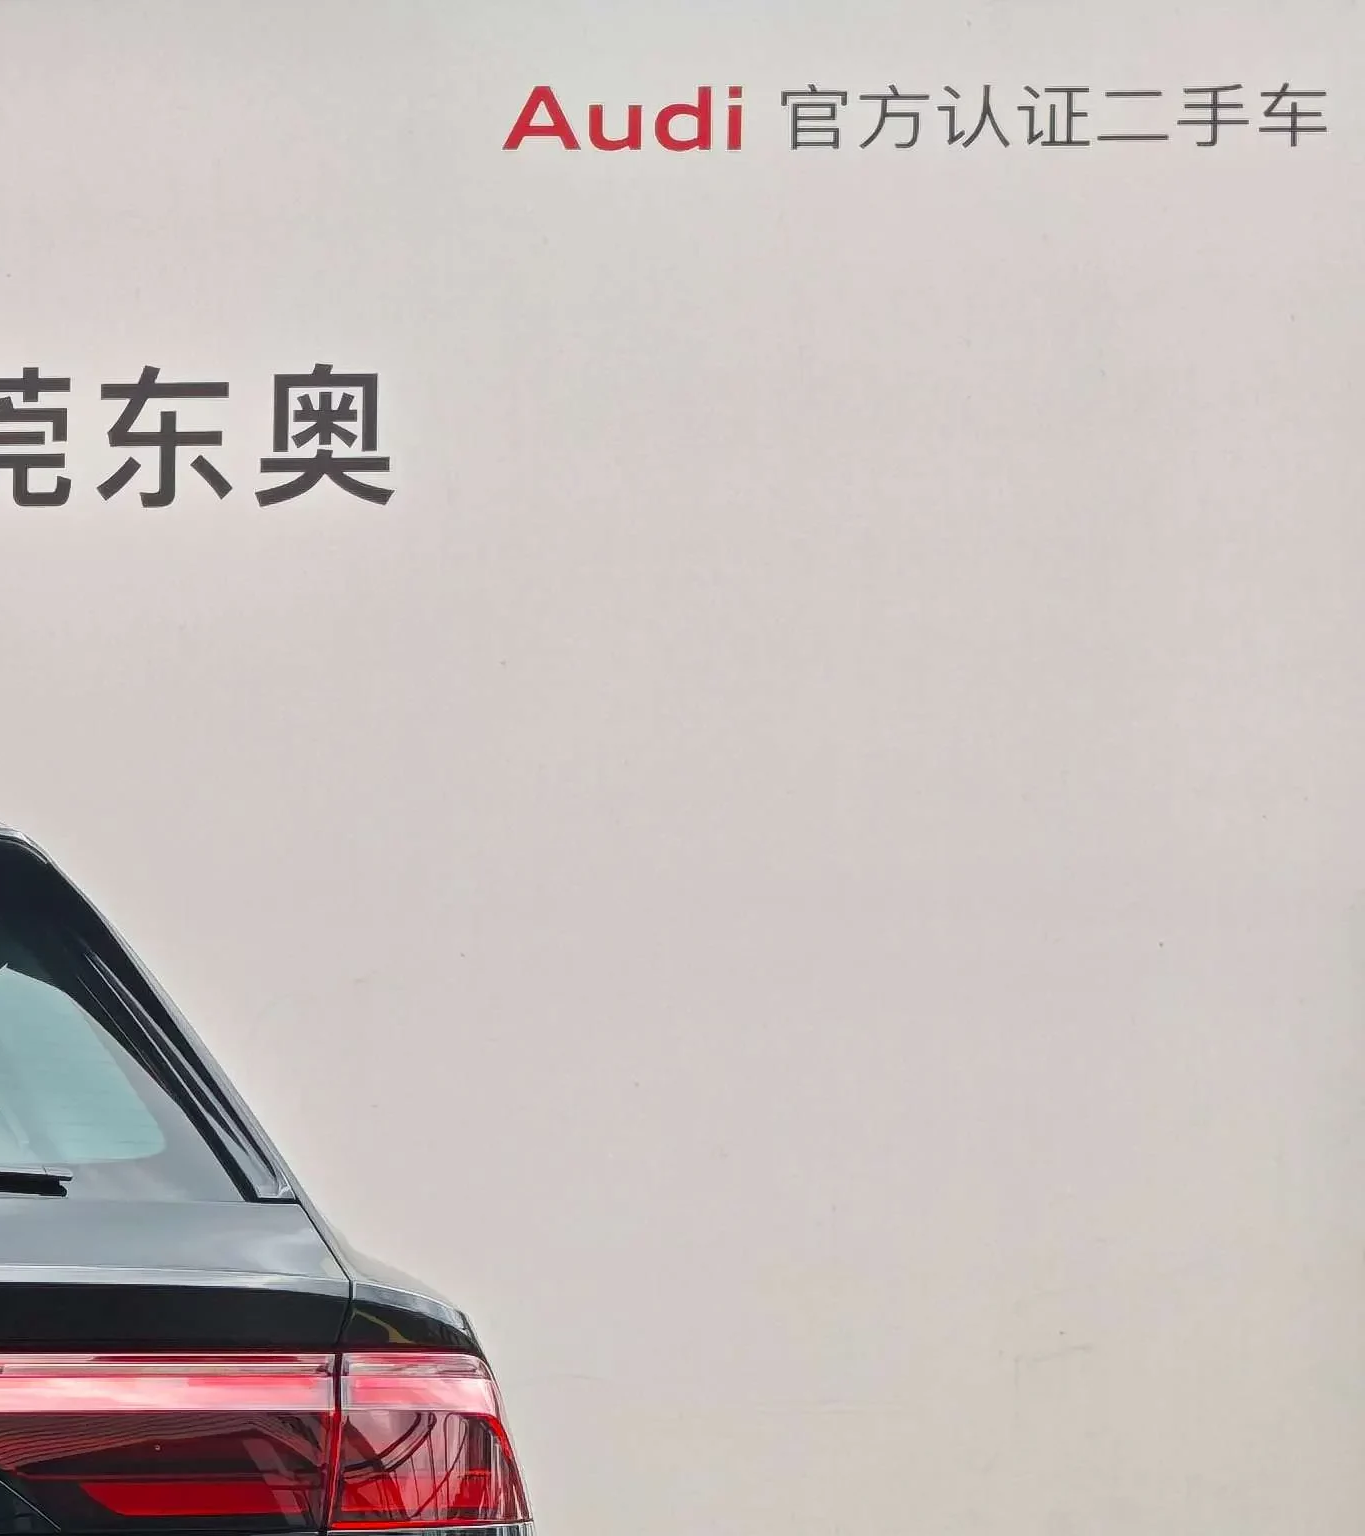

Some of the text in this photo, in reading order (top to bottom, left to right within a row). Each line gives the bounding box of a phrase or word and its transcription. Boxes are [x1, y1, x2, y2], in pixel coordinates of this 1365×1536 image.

[502, 83, 1328, 152] Audi 官方认证二手车
